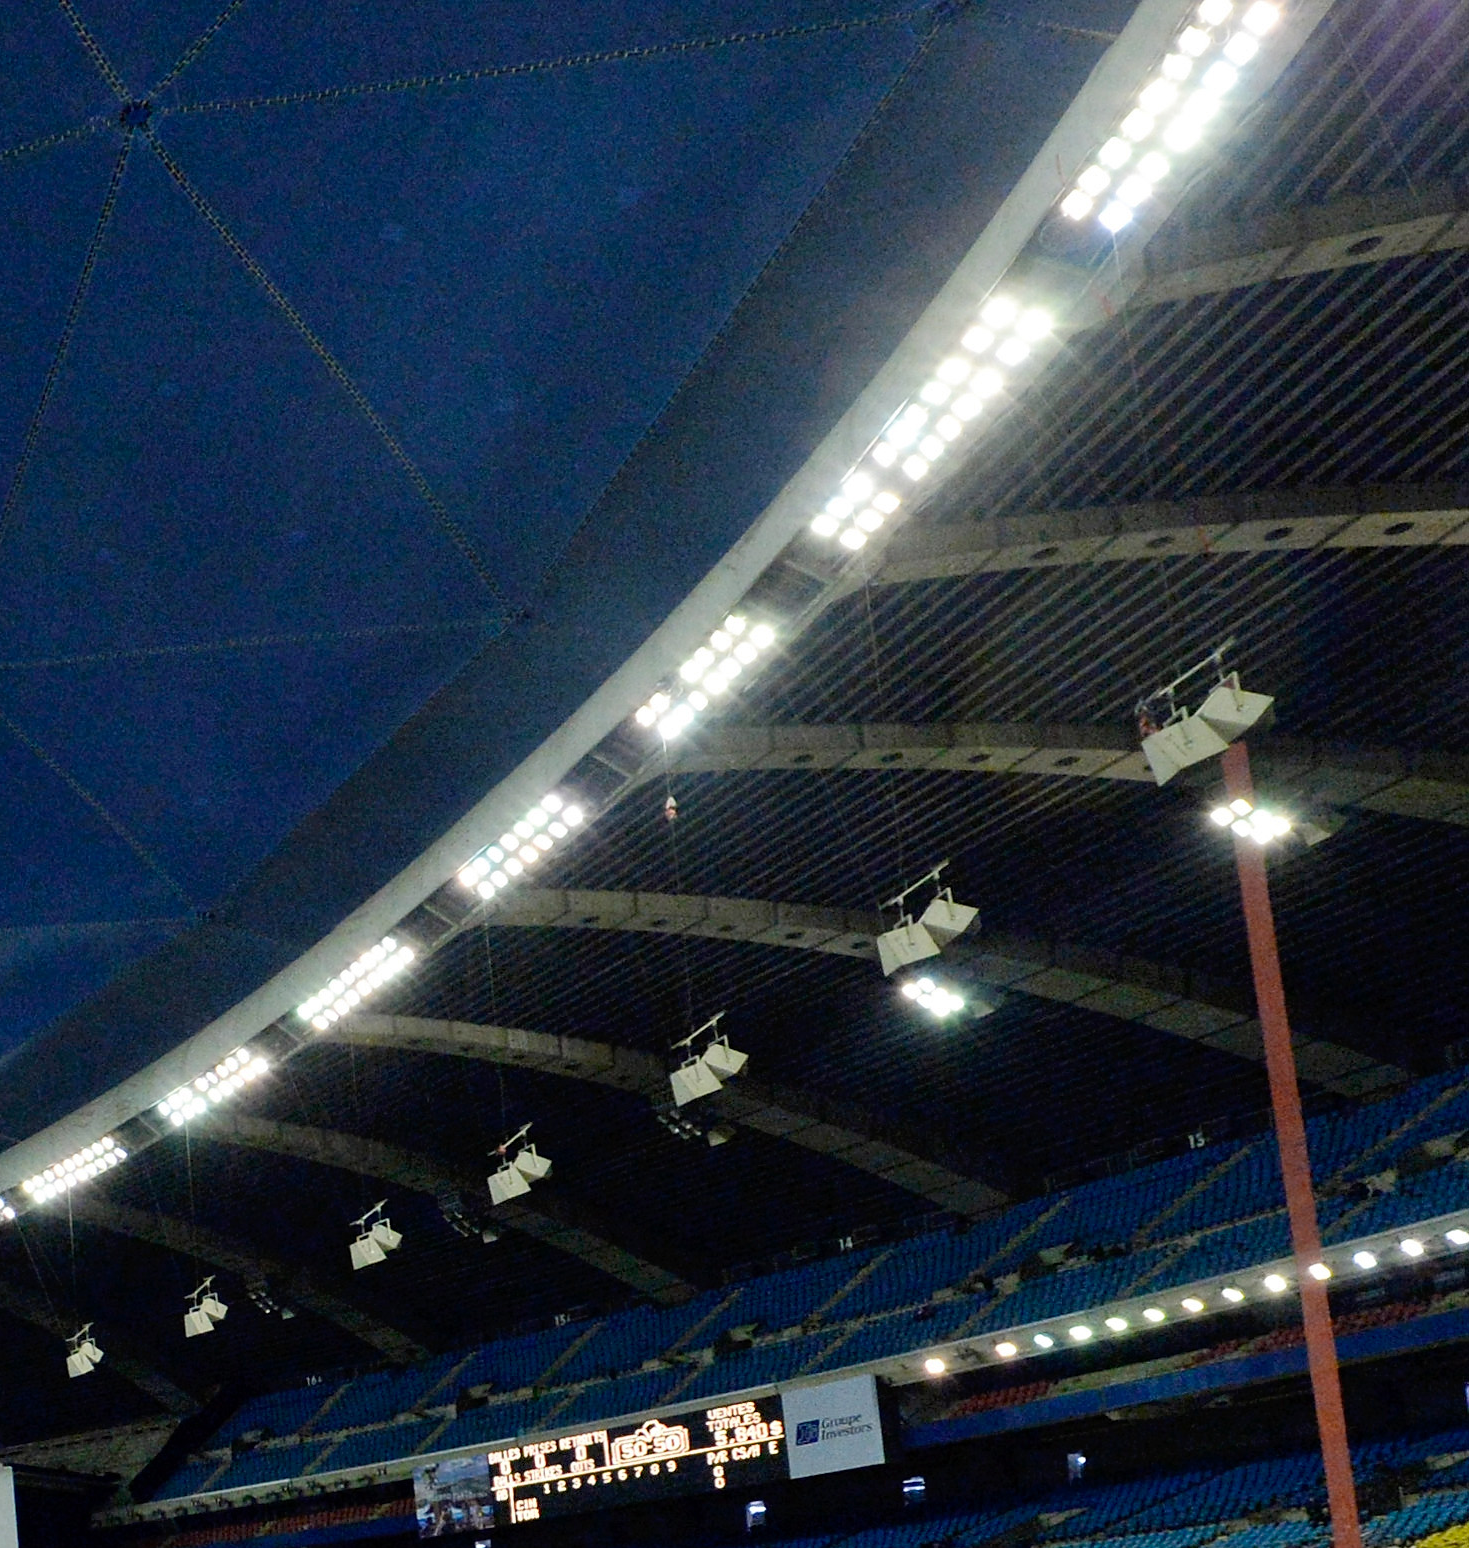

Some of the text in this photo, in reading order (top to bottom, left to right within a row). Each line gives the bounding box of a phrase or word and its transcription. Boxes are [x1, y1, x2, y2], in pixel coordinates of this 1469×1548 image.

[707, 1401, 756, 1420] VENTES
[706, 1412, 762, 1432] TOTALES
[821, 1413, 862, 1429] Groupe
[821, 1423, 873, 1441] Investors
[621, 1434, 681, 1459] 50-50
[768, 1441, 779, 1455] E
[534, 1454, 546, 1468] 0
[575, 1446, 587, 1460] 0
[543, 1483, 551, 1494] 1
[557, 1480, 567, 1492] 2
[572, 1477, 582, 1489] 3
[587, 1475, 597, 1486] 4
[602, 1472, 612, 1484] 5
[617, 1469, 628, 1481] 6
[633, 1465, 644, 1478] 7
[649, 1463, 660, 1476] 8
[666, 1460, 677, 1473] 9
